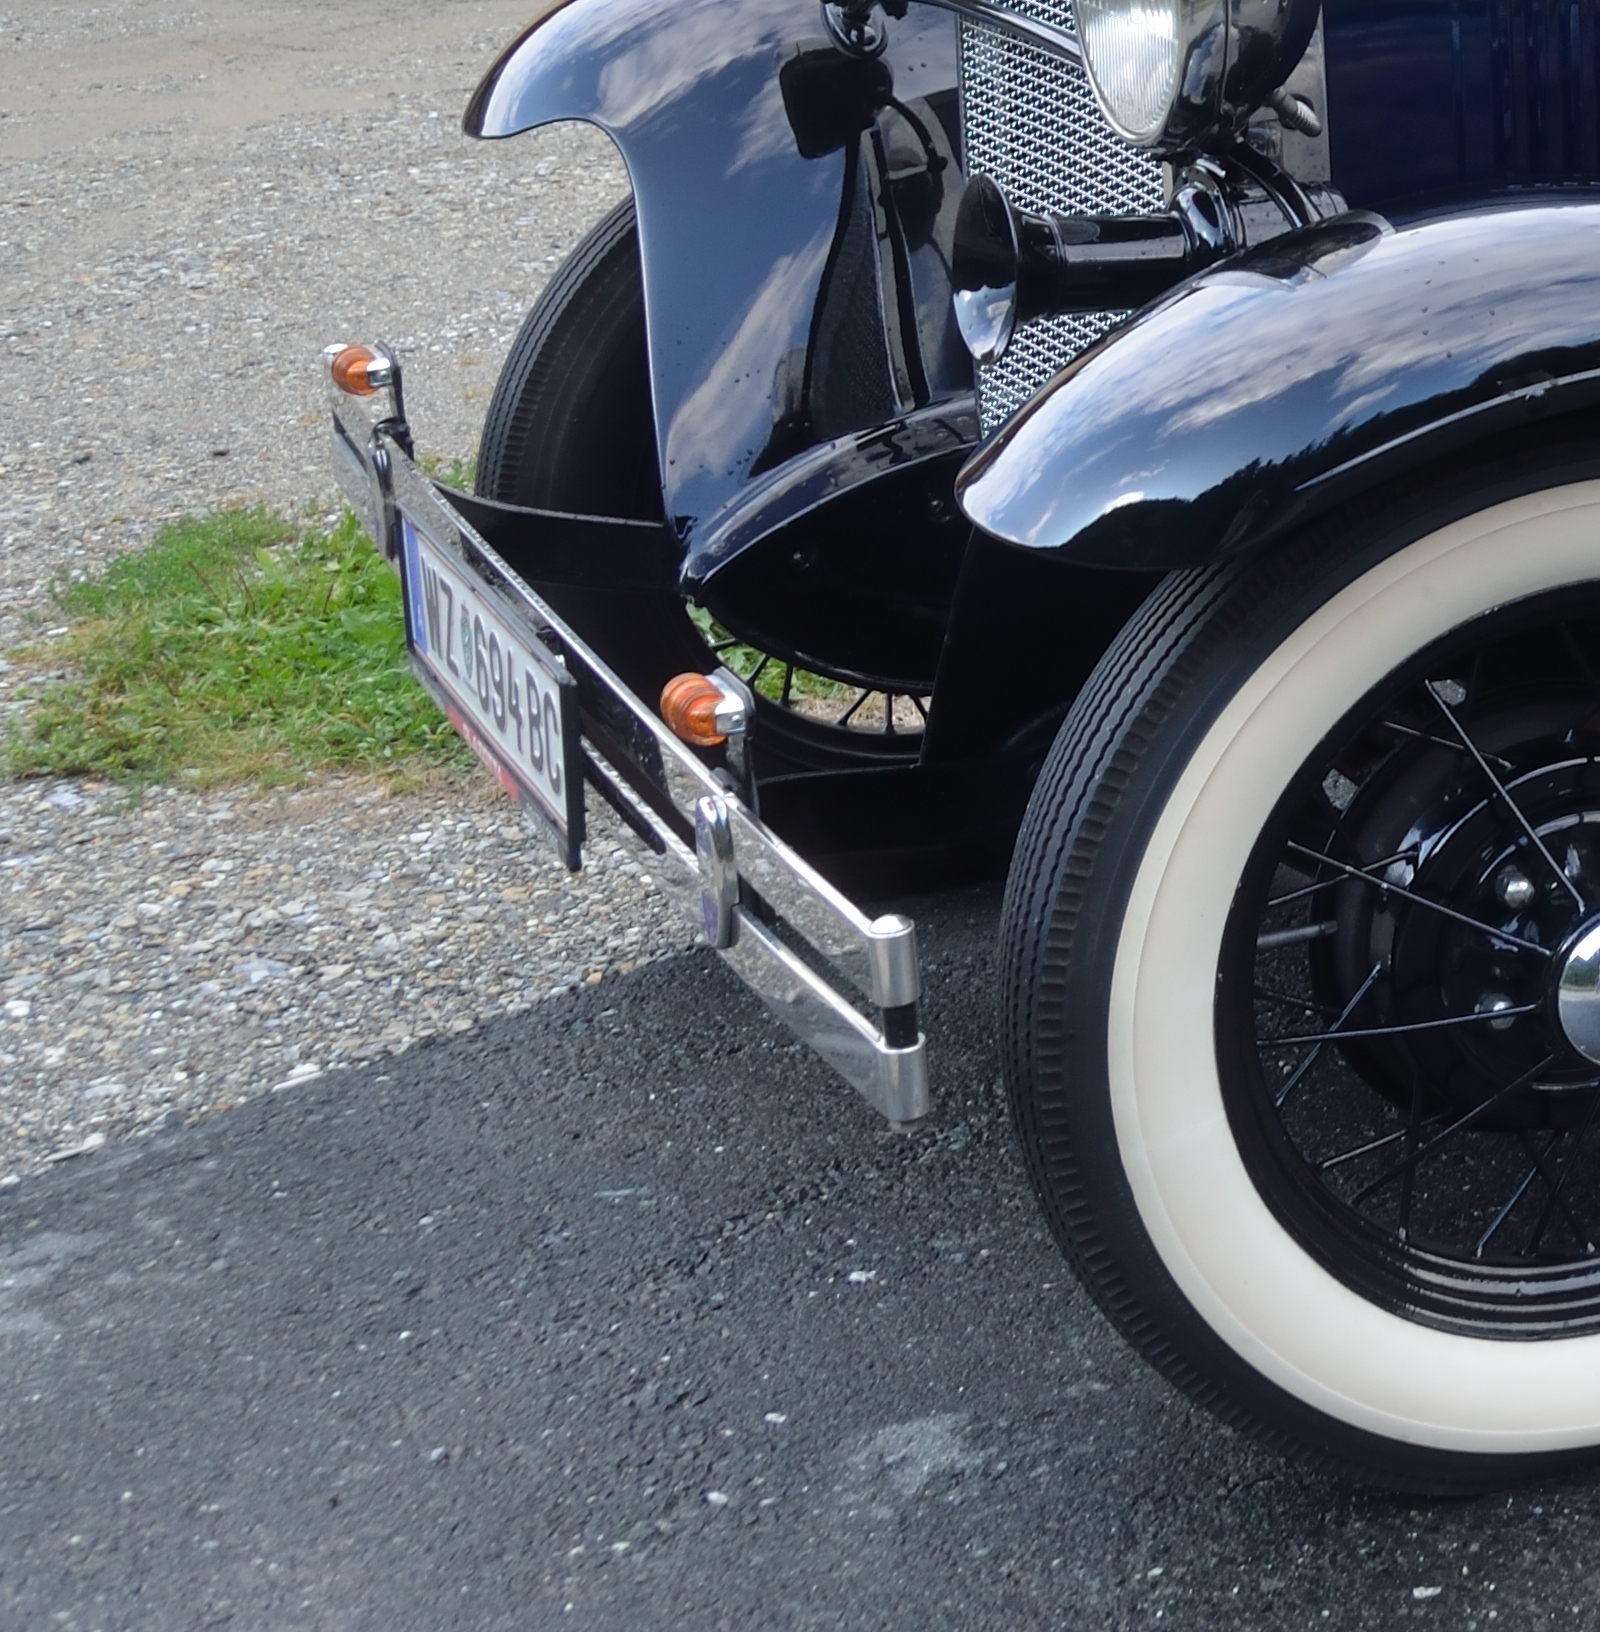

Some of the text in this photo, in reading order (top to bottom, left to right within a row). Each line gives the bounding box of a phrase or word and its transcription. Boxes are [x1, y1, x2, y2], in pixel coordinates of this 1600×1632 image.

[421, 552, 459, 678] WZ
[474, 613, 524, 755] 694
[525, 667, 562, 797] BC
